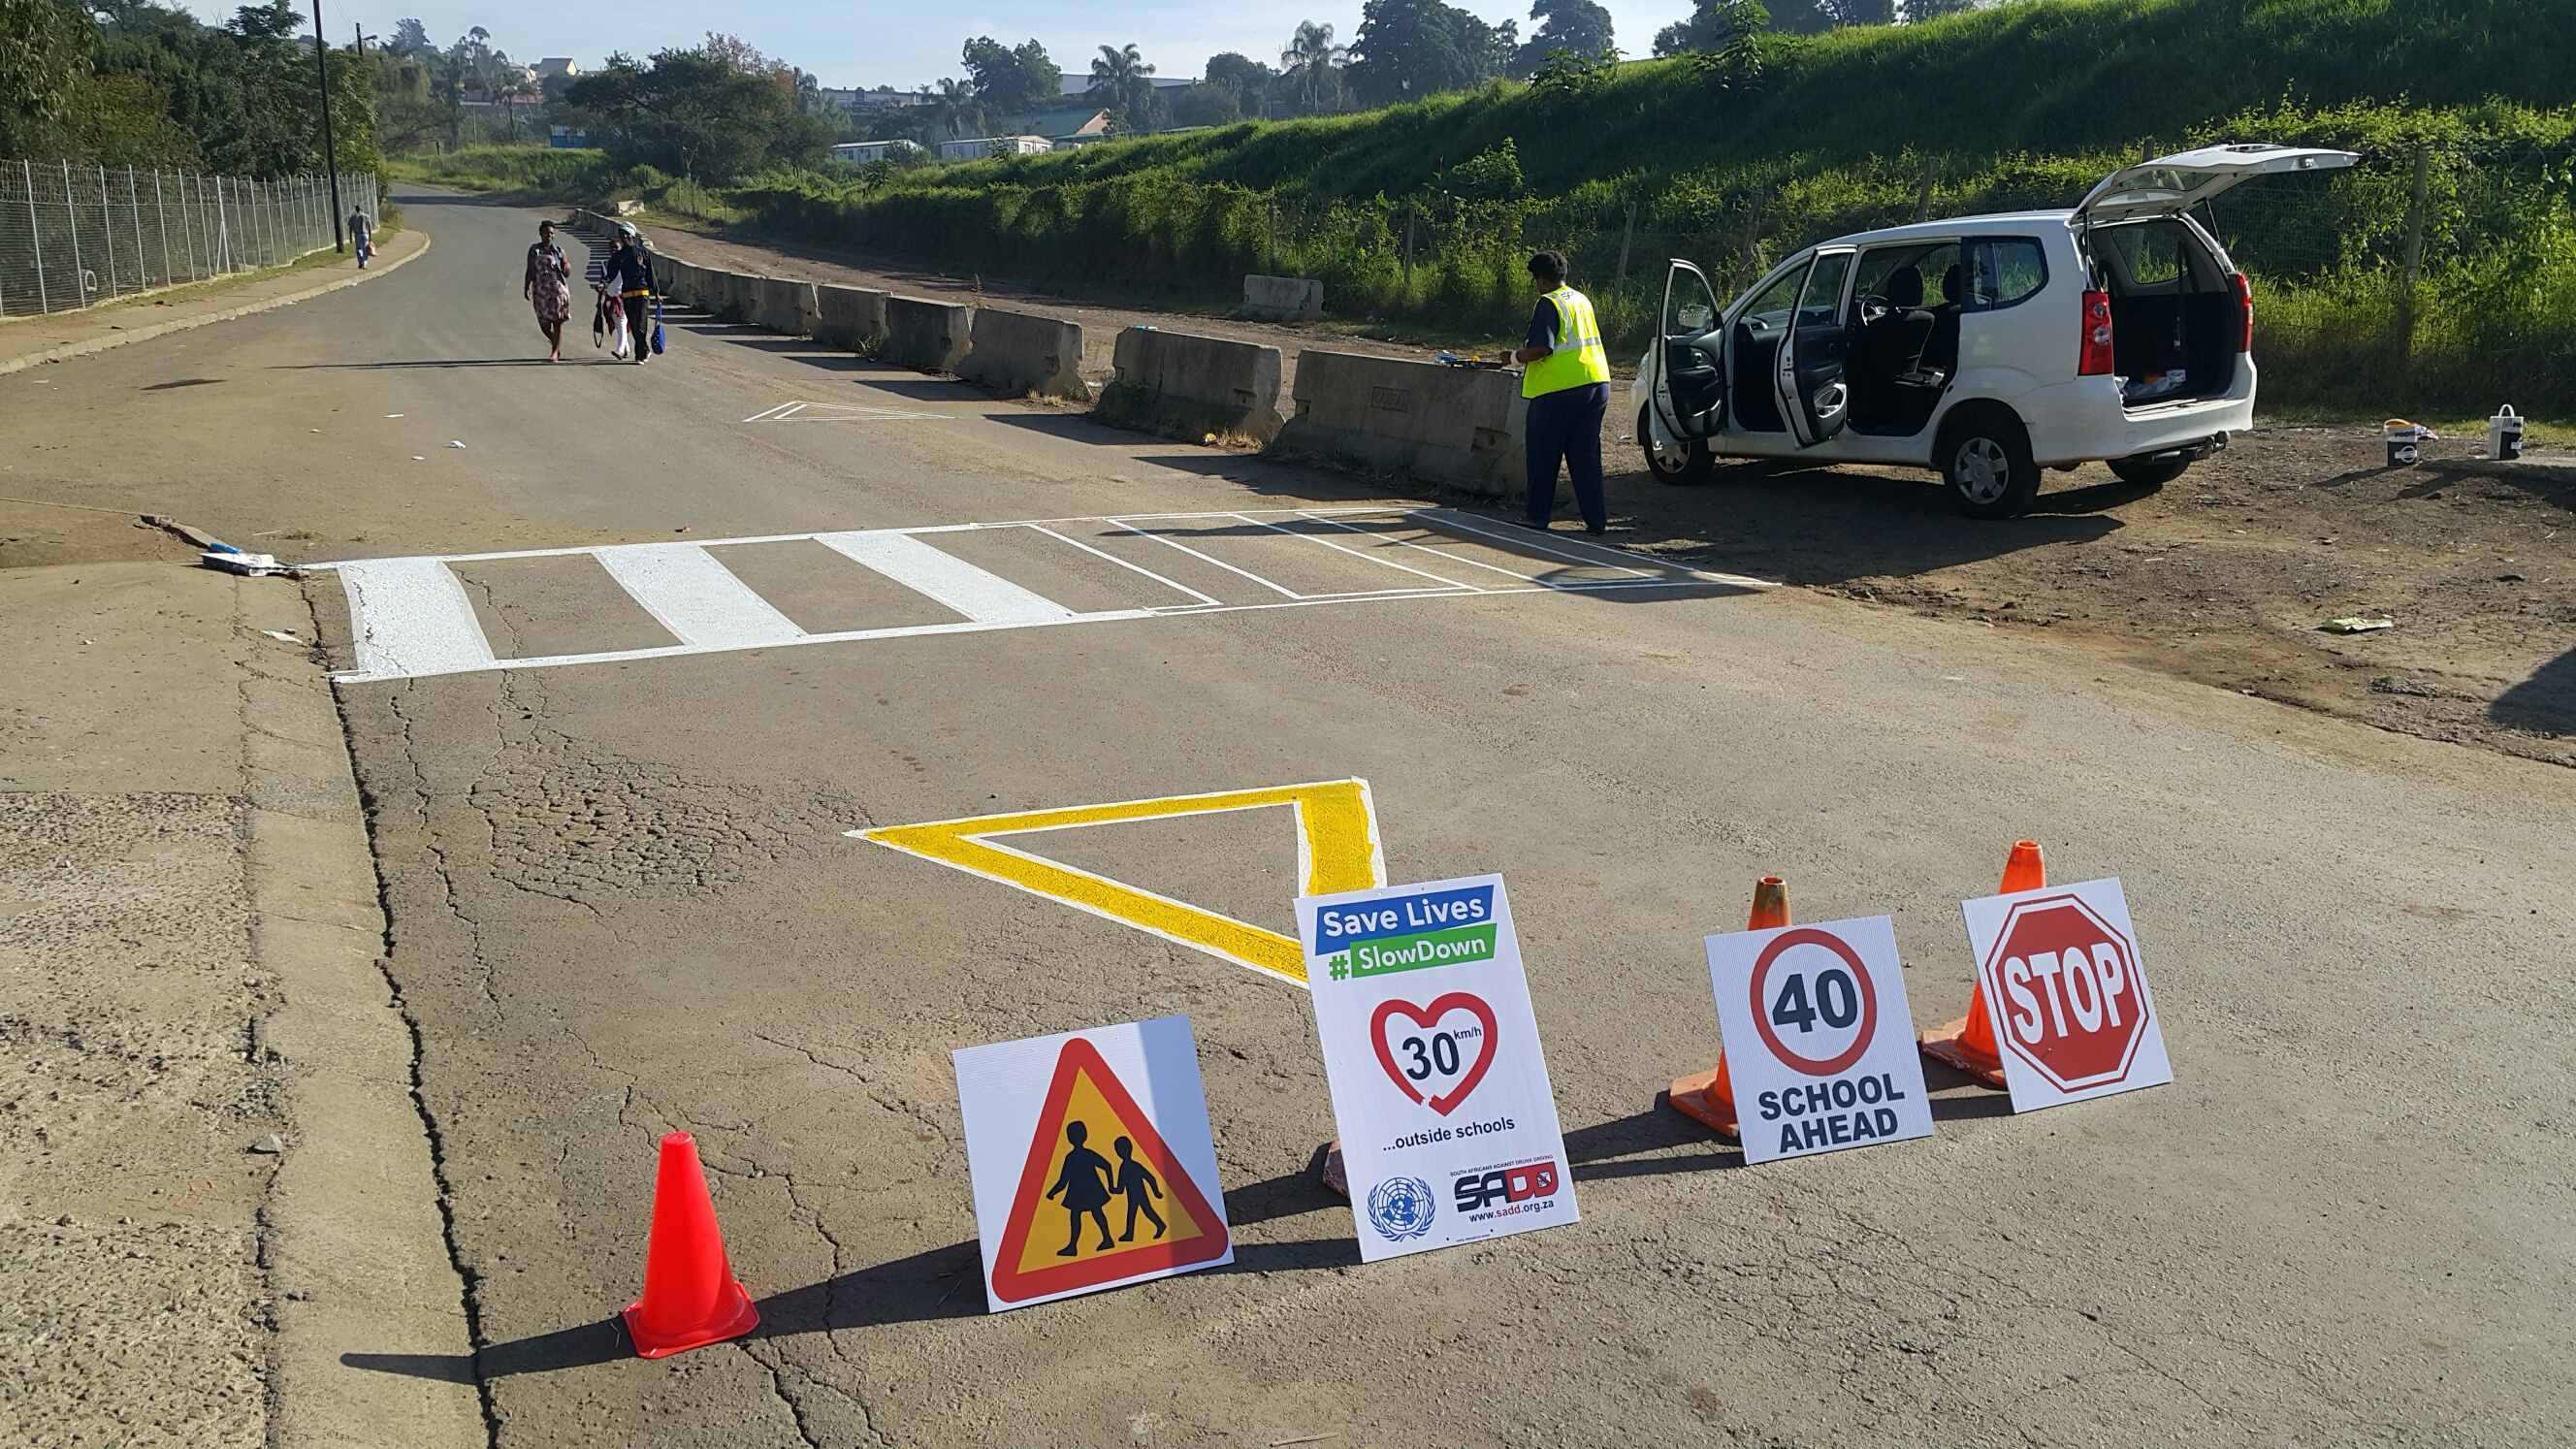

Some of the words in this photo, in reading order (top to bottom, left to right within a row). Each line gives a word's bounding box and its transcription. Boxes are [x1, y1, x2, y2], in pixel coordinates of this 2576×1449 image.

[1323, 910, 1399, 937] Save
[1405, 898, 1485, 926] Lives
[1329, 938, 1487, 981] #SlowDown
[1772, 969, 1858, 1033] 40
[2004, 942, 2125, 1045] STOP
[1401, 1032, 1460, 1080] 30
[1453, 1026, 1482, 1041] km/h
[1758, 1073, 1906, 1120] SCHOOL
[1456, 1116, 1515, 1139] schools
[1779, 1108, 1898, 1154] AHEAD
[1449, 1169, 1467, 1177] SOUTH
[1467, 1164, 1493, 1174] AFRICANS
[1494, 1160, 1515, 1170] AGAINST
[1515, 1157, 1533, 1166] DRUNK
[1532, 1153, 1554, 1162] DRIVING
[1454, 1161, 1560, 1212] SADD
[1468, 1200, 1555, 1223] www.sadd.org.za
